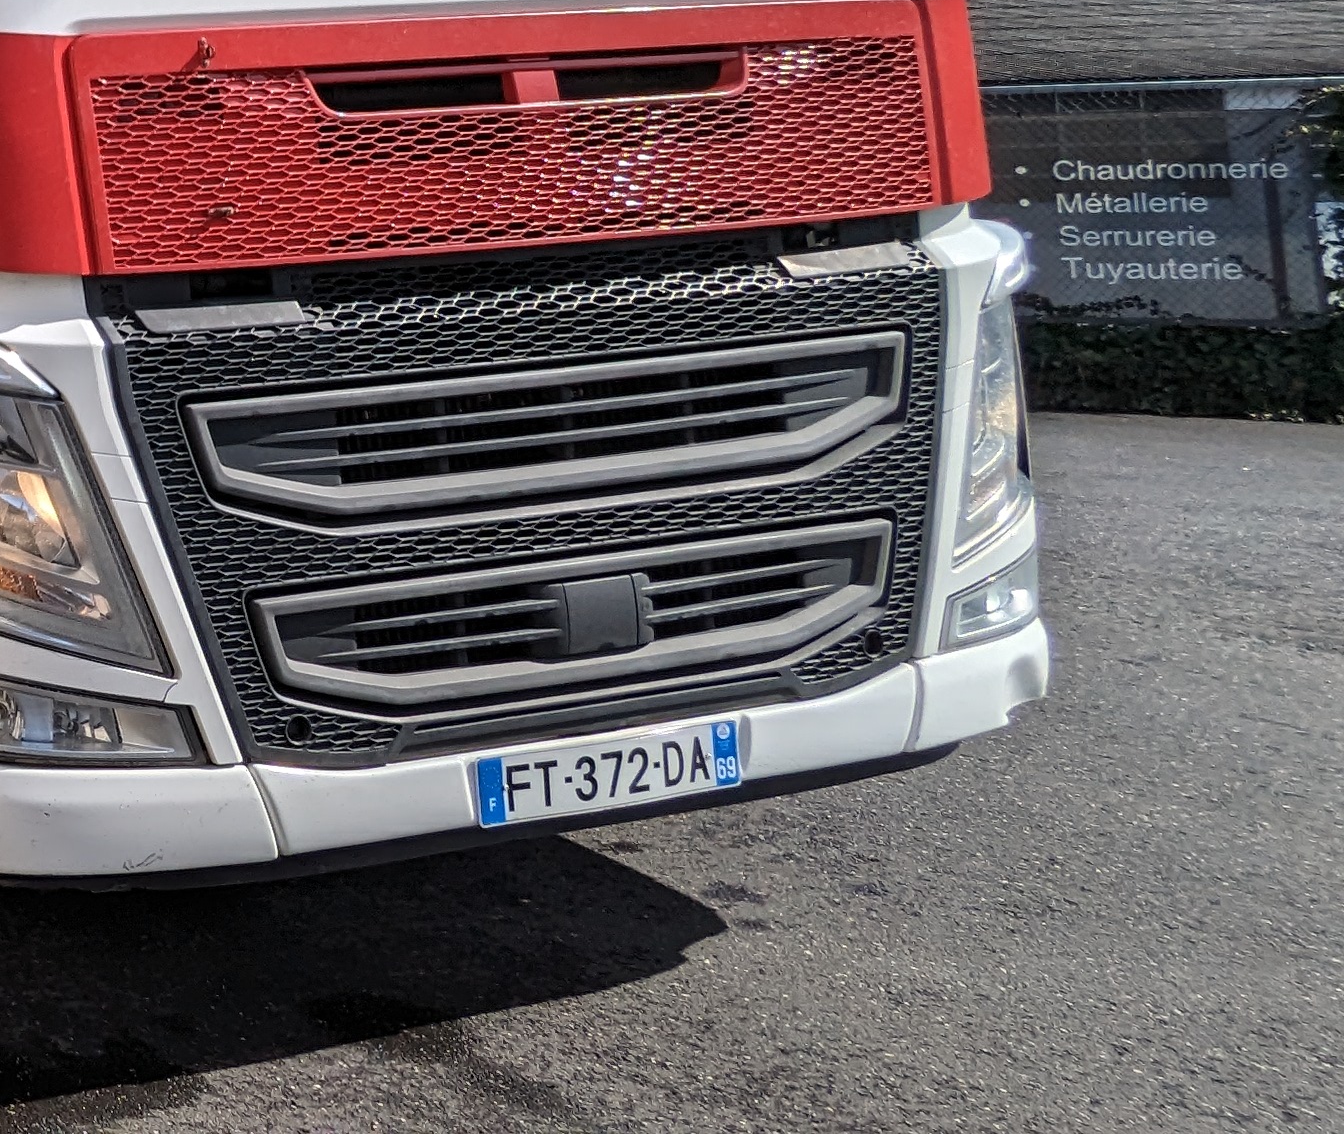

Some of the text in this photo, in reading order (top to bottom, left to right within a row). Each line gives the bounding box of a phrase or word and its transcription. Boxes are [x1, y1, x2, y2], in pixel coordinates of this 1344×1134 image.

[1052, 158, 1290, 183] Chaudronnerie
[1056, 192, 1209, 215] Métallerie
[1058, 225, 1217, 248] Serrurerie
[1060, 256, 1244, 286] Tuyauterie
[488, 797, 498, 813] F
[505, 736, 711, 812] FT-372-DA
[716, 755, 737, 780] 69
